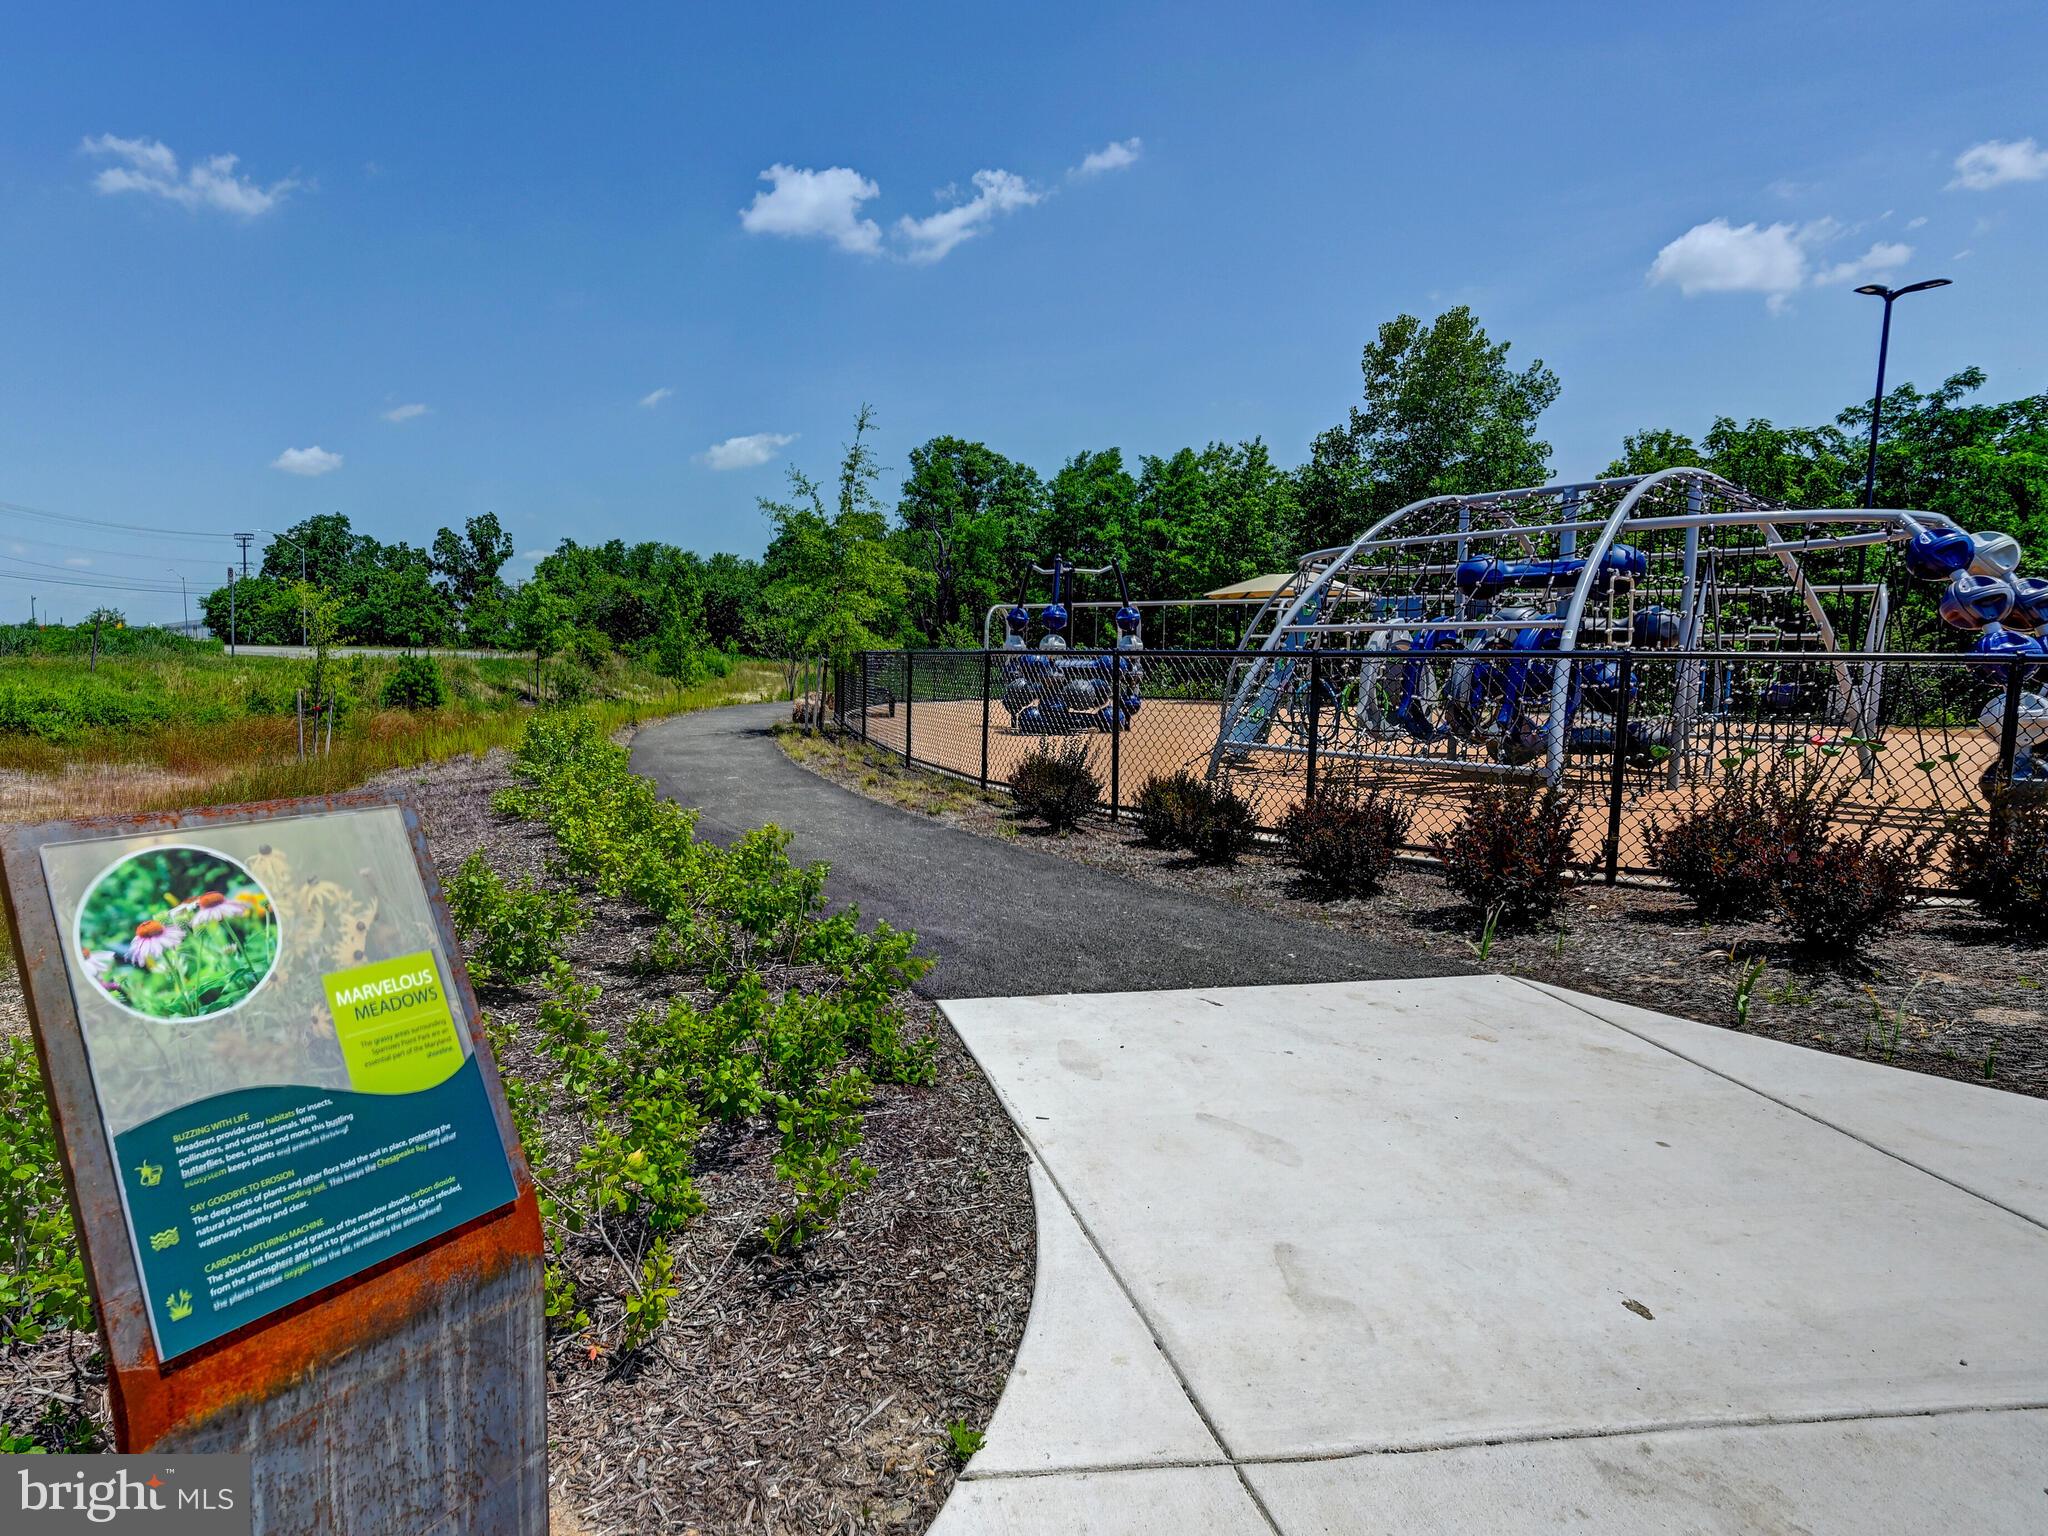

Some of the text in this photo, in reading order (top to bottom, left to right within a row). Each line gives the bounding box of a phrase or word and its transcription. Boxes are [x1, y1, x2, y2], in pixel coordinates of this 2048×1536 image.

[335, 968, 433, 1007] MARVELOUS
[354, 986, 438, 1021] MEADOWS
[173, 1112, 250, 1143] BUZZING WITH LIFE
[176, 1098, 334, 1154] Meadows provide cozy habitats for insects,
[178, 1114, 317, 1167] pollinators, and various animals. With
[180, 1113, 354, 1180] butterflies, bees, rabbits and more, this bustling
[184, 1168, 226, 1188] ecosystem
[228, 1160, 250, 1174] keeps
[252, 1151, 276, 1166] plants
[276, 1145, 291, 1156] and
[292, 1136, 320, 1152] animals
[192, 1123, 451, 1225] The deep roots of plants and other flora hold the soil in place, protecting the
[196, 1219, 226, 1237] natural
[226, 1206, 262, 1225] shoreline
[262, 1199, 282, 1212] from
[282, 1188, 312, 1204] eroding
[328, 1176, 344, 1187] This
[344, 1168, 364, 1182] keeps
[365, 1163, 376, 1174] the
[376, 1147, 415, 1168] Chesapeake
[415, 1142, 428, 1153] Bay
[428, 1137, 440, 1149] and
[190, 1169, 295, 1214] SAY GOODBYE TO EROSION
[199, 1200, 309, 1248] waterways healthy and clear.
[204, 1218, 324, 1273] CARBON-CAPTURING MACHINE
[207, 1176, 456, 1285] The abundant flowers and grasses of the meadow absorb carbon dioxide
[210, 1283, 231, 1297] from
[232, 1276, 246, 1288] the
[247, 1256, 294, 1282] atmosphere
[294, 1248, 309, 1262] and
[310, 1243, 323, 1254] use
[324, 1240, 330, 1248] it
[330, 1237, 339, 1246] to
[340, 1225, 368, 1245] produce
[368, 1216, 385, 1230] their
[386, 1210, 400, 1222] own
[400, 1202, 418, 1216] food.
[418, 1195, 436, 1209] Once
[214, 1300, 228, 1312] the
[229, 1287, 254, 1306] plants
[256, 1275, 282, 1293] release
[284, 1262, 312, 1280] oxygen
[312, 1256, 328, 1268] into
[328, 1249, 340, 1260] the
[354, 1228, 390, 1250] revitalizing
[390, 1221, 402, 1232] the
